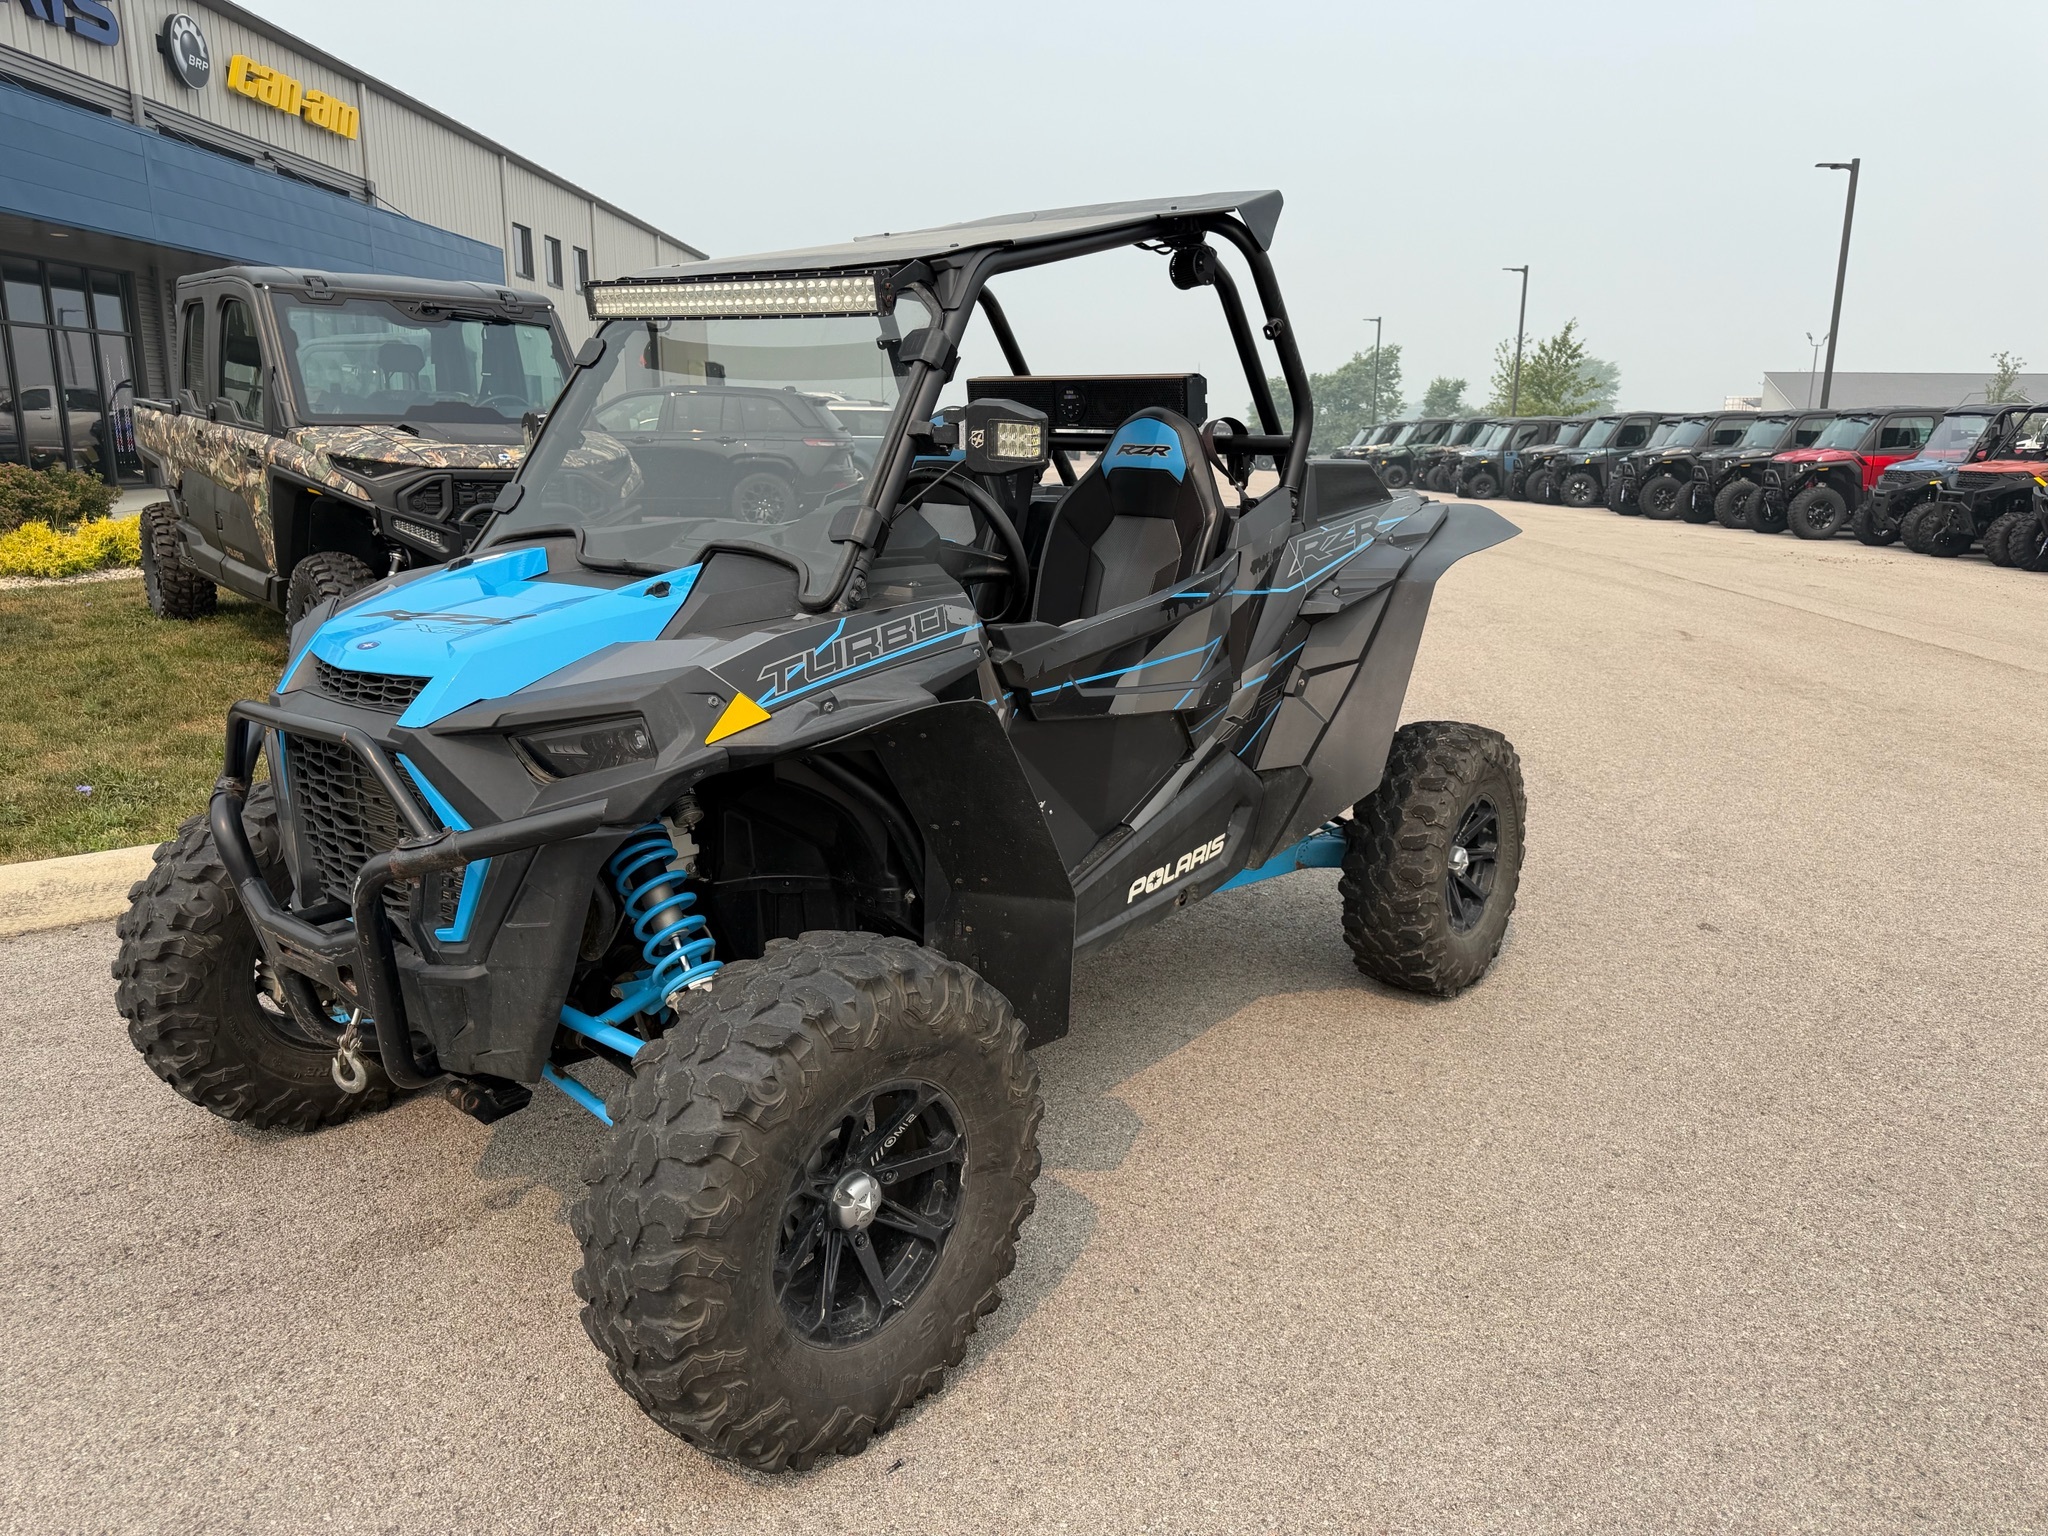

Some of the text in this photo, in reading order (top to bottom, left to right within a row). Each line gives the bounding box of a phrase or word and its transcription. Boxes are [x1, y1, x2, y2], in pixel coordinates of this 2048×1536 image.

[188, 53, 209, 71] BRP
[228, 54, 360, 140] can-am
[1116, 443, 1171, 458] RZR
[1287, 514, 1382, 578] RZR
[756, 603, 949, 697] TURBO
[1127, 833, 1226, 904] POLARIS
